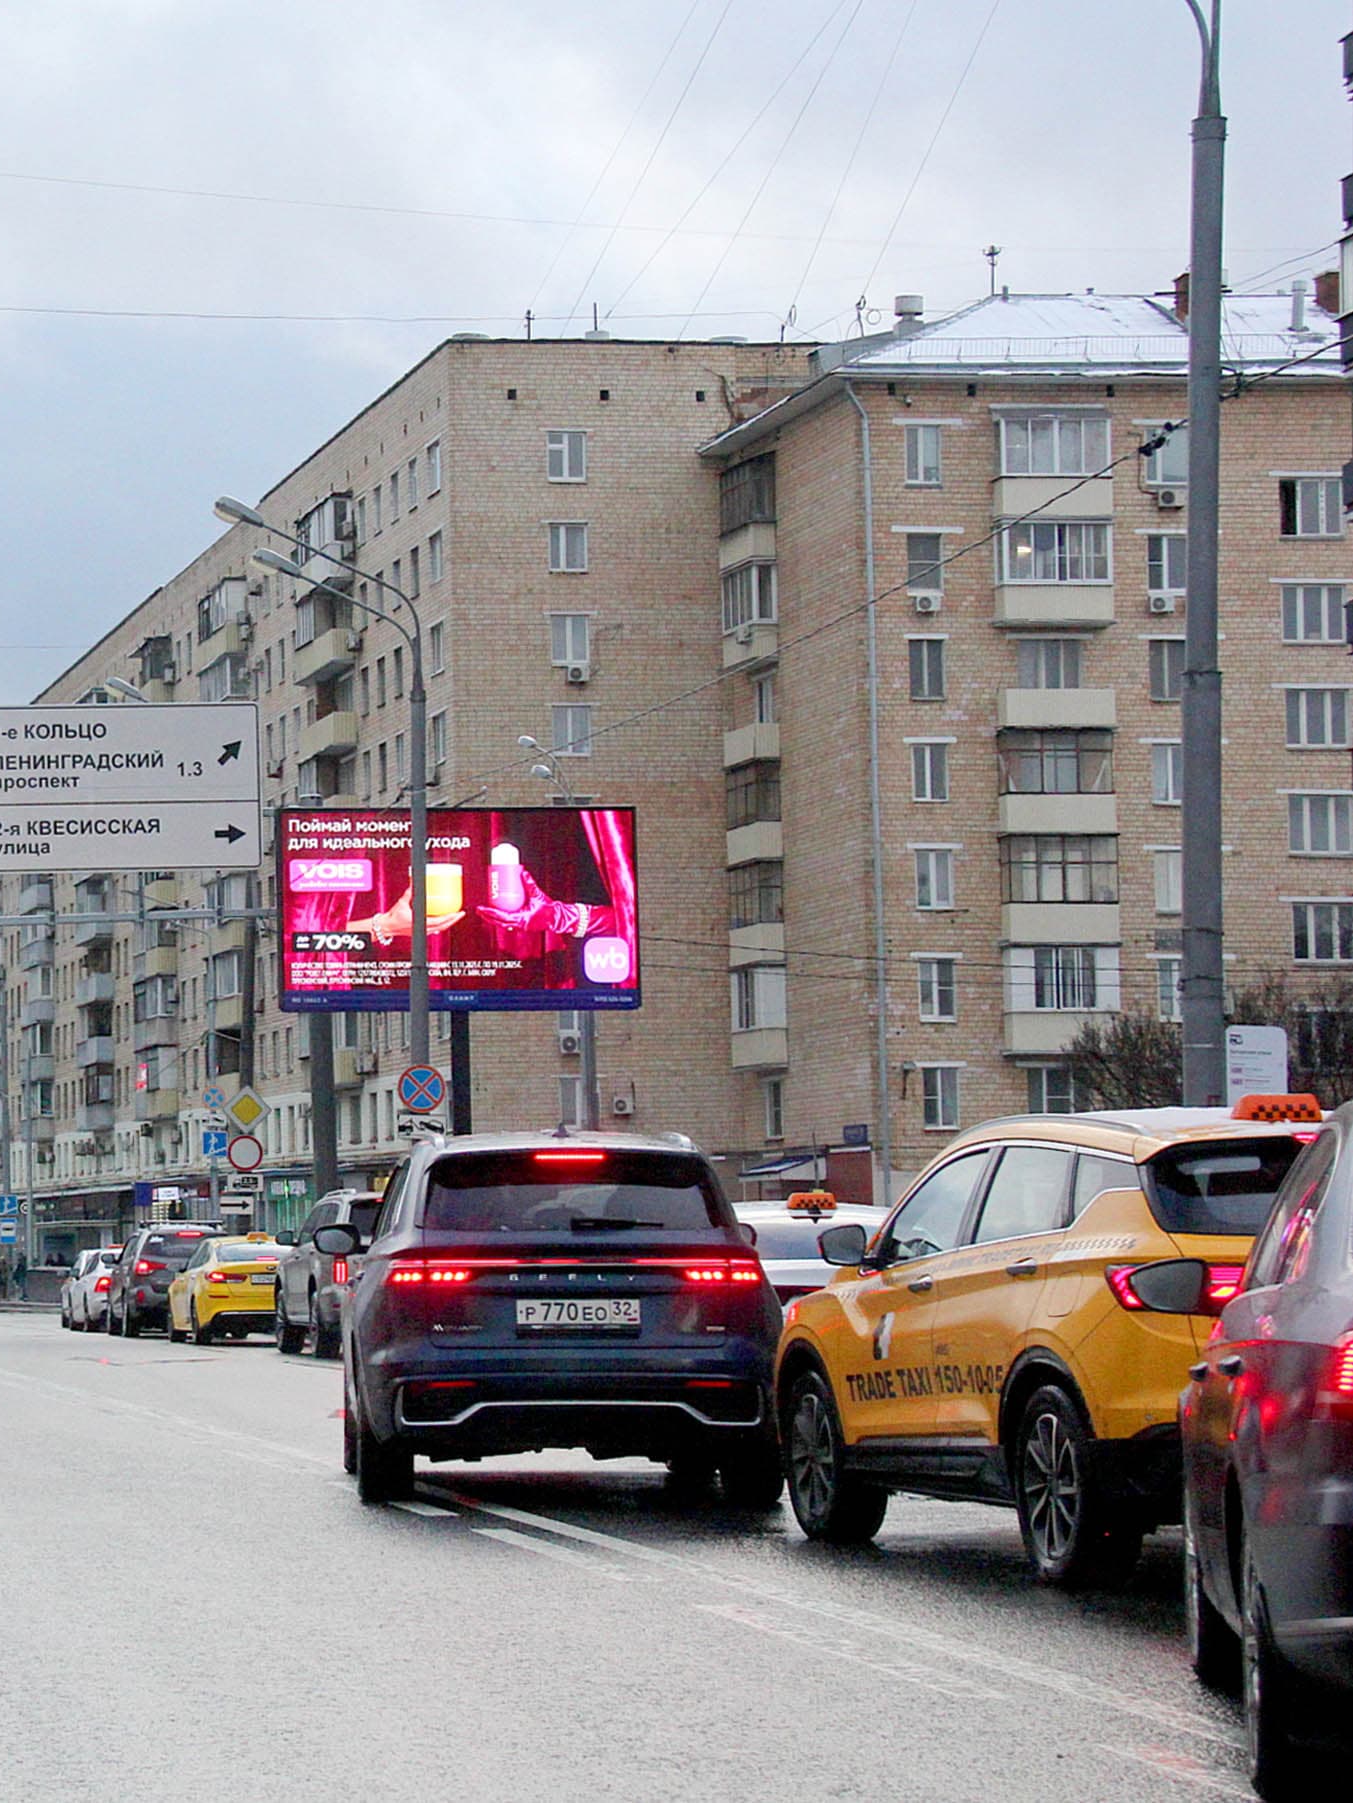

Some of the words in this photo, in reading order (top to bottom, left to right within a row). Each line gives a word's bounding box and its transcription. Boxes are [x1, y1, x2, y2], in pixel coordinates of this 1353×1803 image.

[23, 722, 107, 741] КОЛЬЦО
[176, 762, 203, 777] 1.3
[26, 818, 161, 837] КВЕСИССКАЯ
[288, 818, 352, 833] Поймай
[288, 837, 318, 851] для
[299, 863, 365, 879] VOIS
[588, 945, 627, 969] wb
[509, 1273, 637, 1281] GEELY
[846, 1370, 897, 1401] TRADE
[896, 1366, 934, 1397] TAXI
